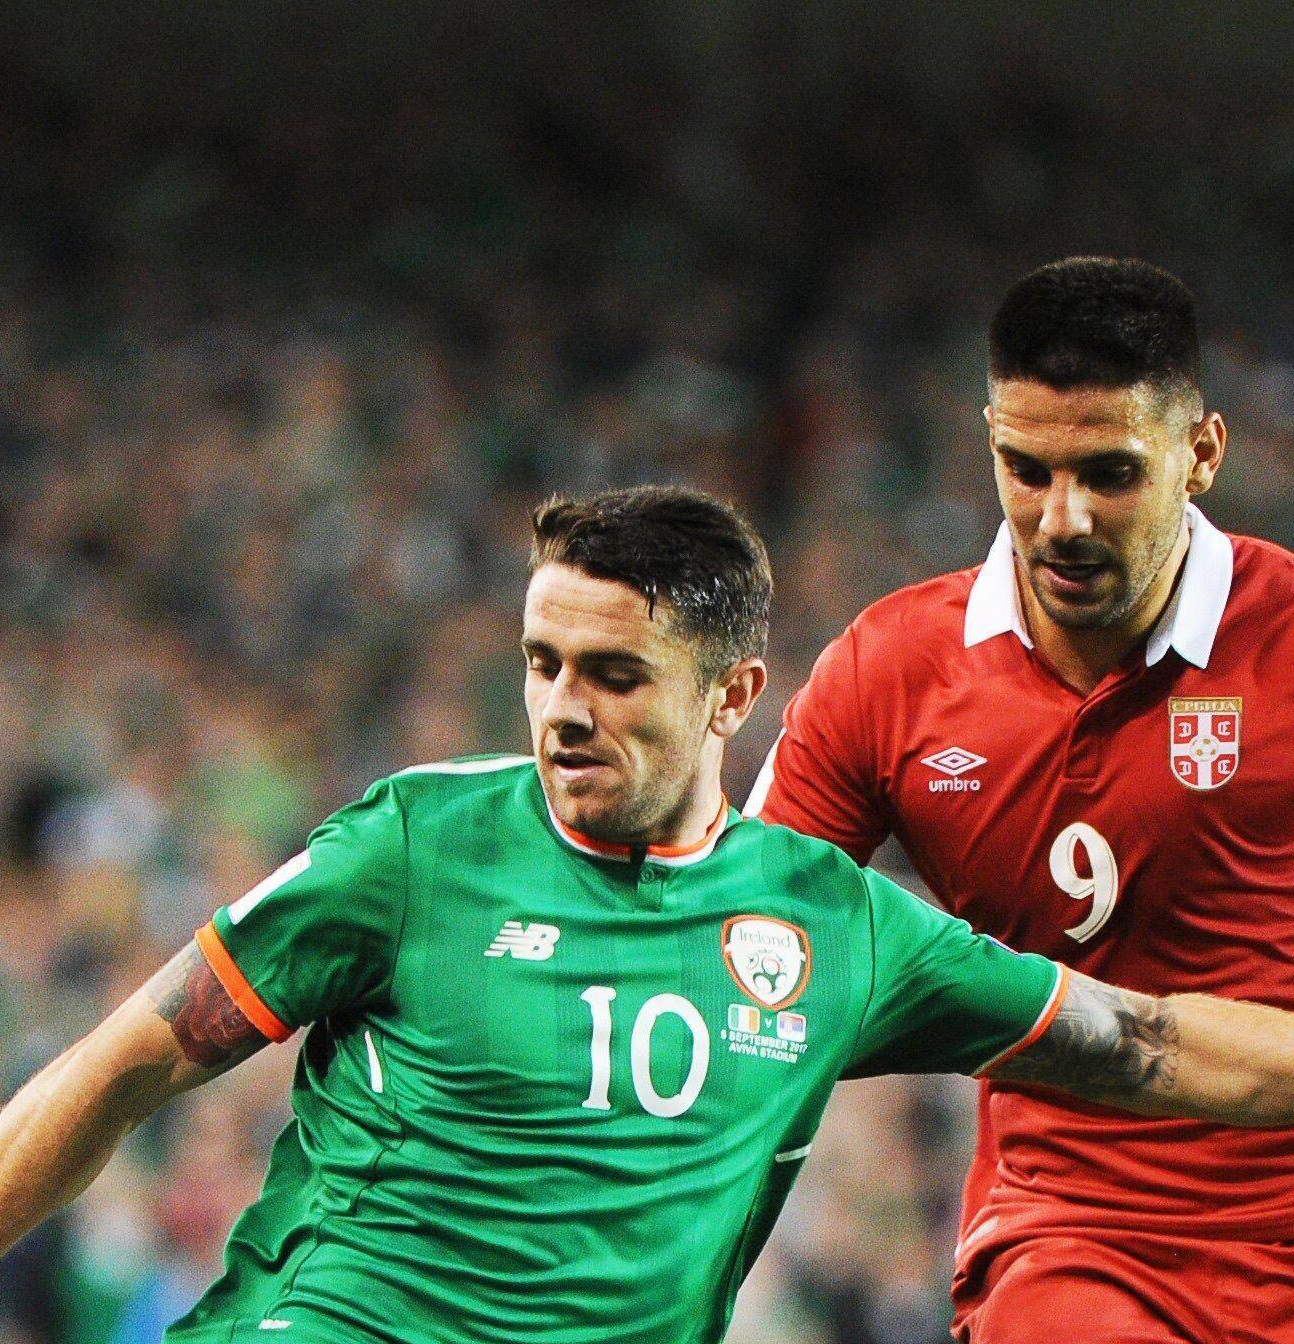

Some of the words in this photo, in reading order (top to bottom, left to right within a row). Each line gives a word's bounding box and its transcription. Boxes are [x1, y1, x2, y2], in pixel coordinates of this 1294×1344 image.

[928, 776, 981, 792] umbro
[1048, 821, 1119, 944] 9
[739, 927, 790, 948] Ireland
[580, 985, 710, 1118] 10
[728, 1042, 758, 1056] AVIVA
[760, 1047, 798, 1064] STADIUM
